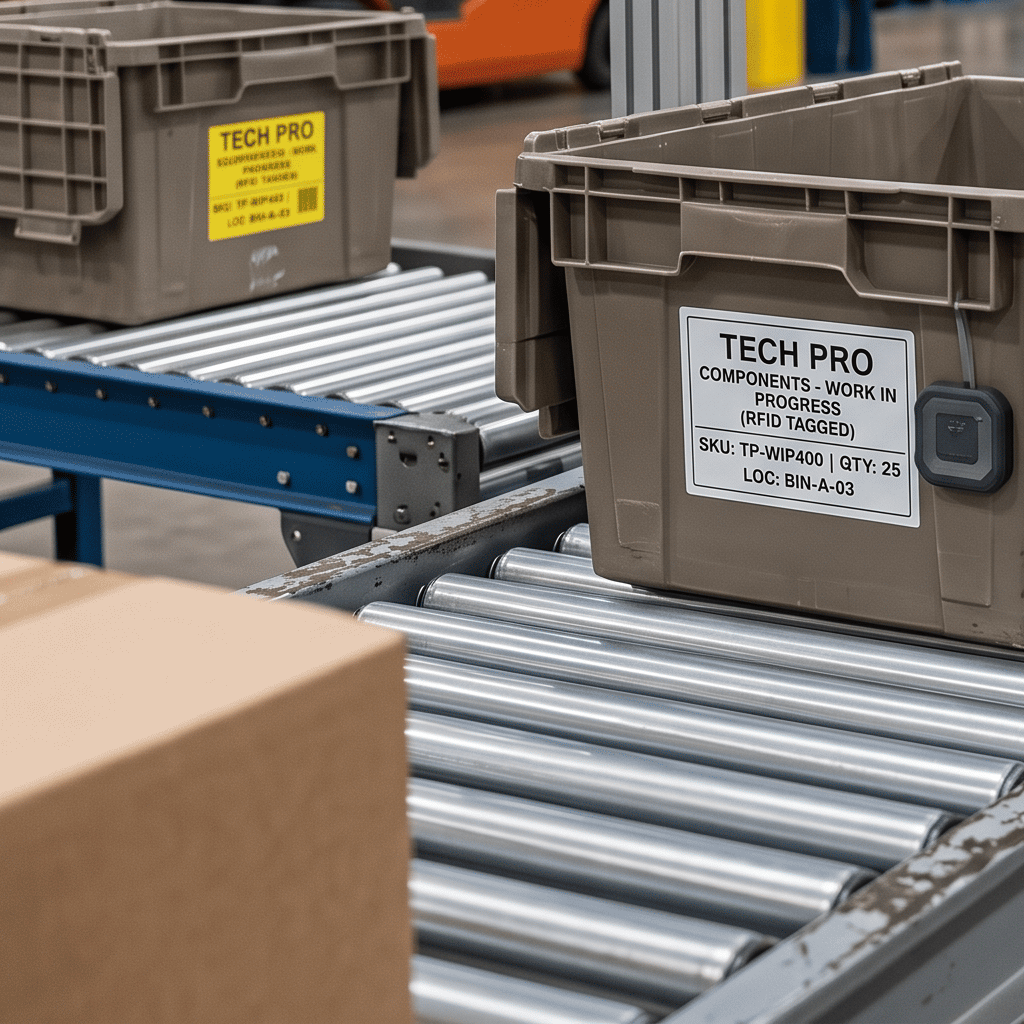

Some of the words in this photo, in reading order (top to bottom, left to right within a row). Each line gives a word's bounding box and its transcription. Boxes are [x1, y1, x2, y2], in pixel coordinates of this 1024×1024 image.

[220, 126, 269, 151] TECH
[276, 120, 314, 143] PRO
[719, 332, 799, 368] TECH
[810, 342, 874, 376] PRO
[699, 365, 811, 393] COMPONENTS
[825, 380, 876, 401] WORK
[880, 387, 897, 403] IN
[755, 392, 841, 416] PROGRESS
[740, 410, 782, 428] (RFID
[786, 416, 855, 441] TAGGED)
[699, 437, 735, 455] SKU:
[739, 442, 824, 467] TP-WIP400
[839, 455, 877, 474] QTY:
[881, 461, 901, 478] 25
[743, 467, 780, 486] LOC:
[784, 472, 855, 496] BIN-A-03
